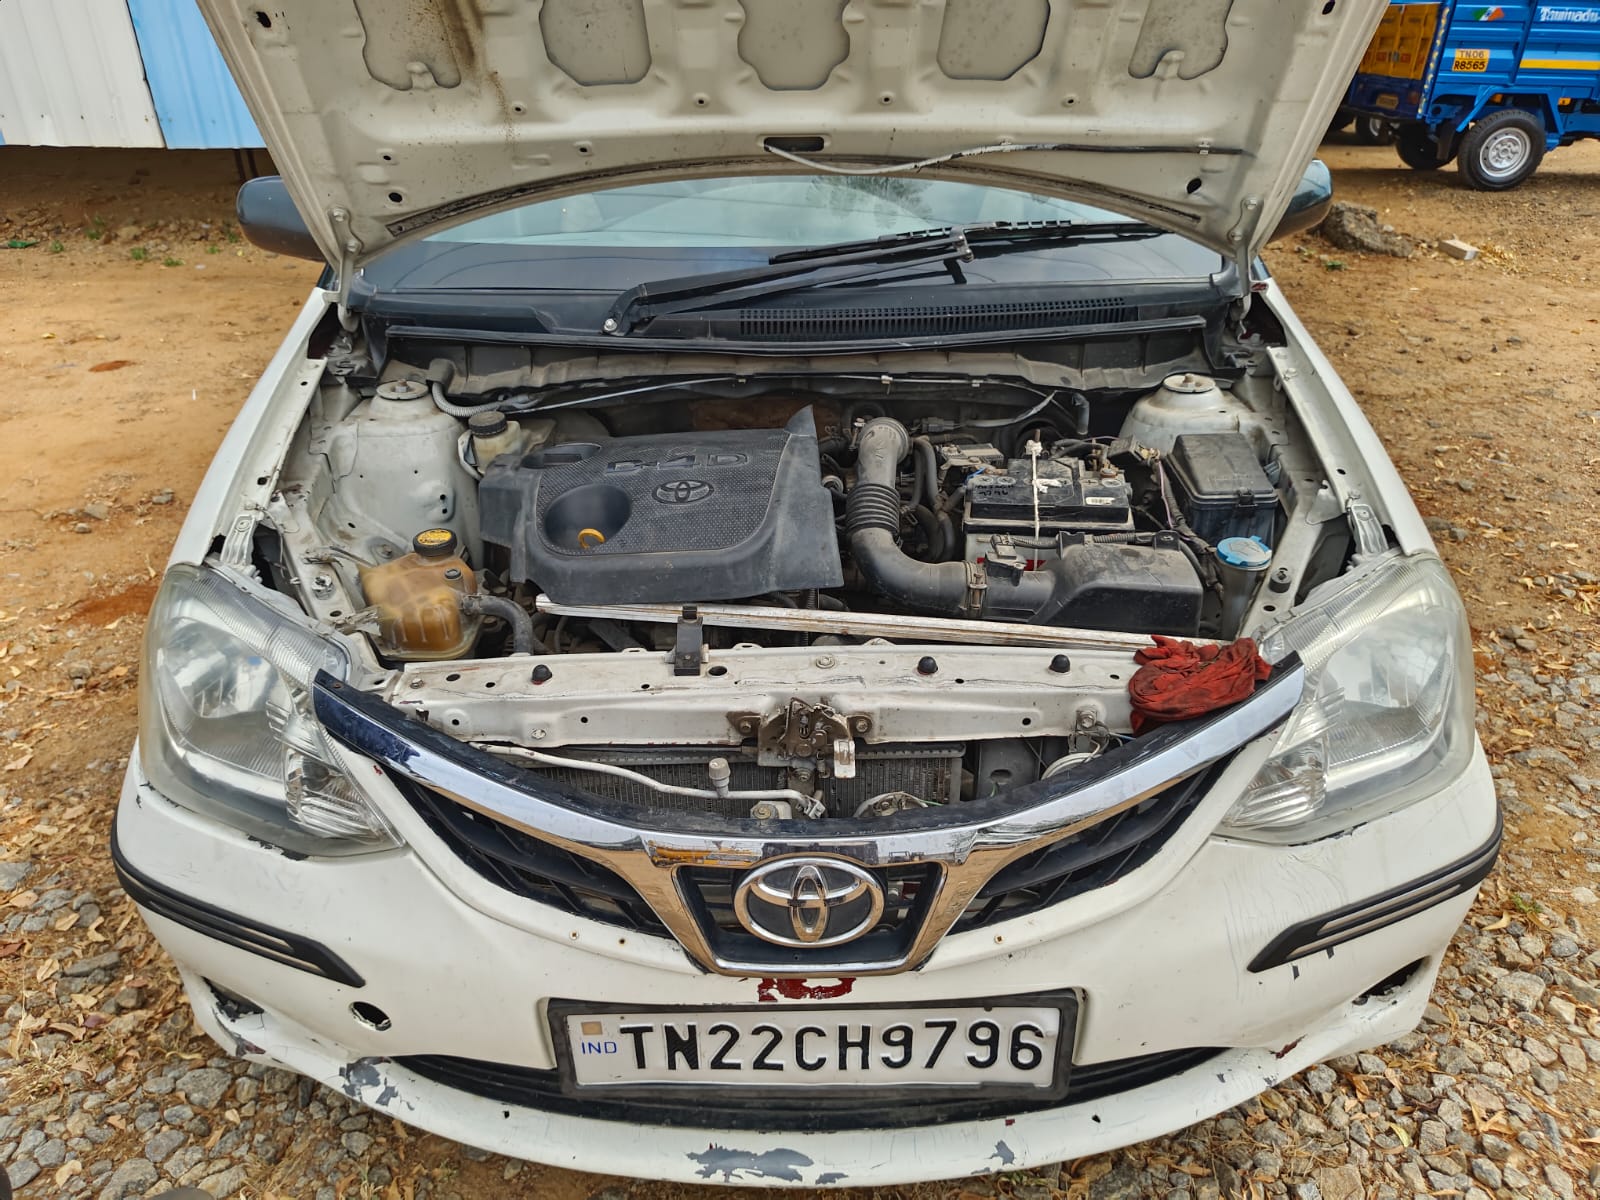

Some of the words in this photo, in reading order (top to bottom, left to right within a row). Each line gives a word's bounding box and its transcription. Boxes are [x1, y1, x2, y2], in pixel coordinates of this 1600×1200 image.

[1458, 50, 1485, 59] TN06
[1453, 60, 1485, 70] R8565
[582, 1041, 617, 1055] IND
[619, 1020, 1044, 1072] TN22CH9796
